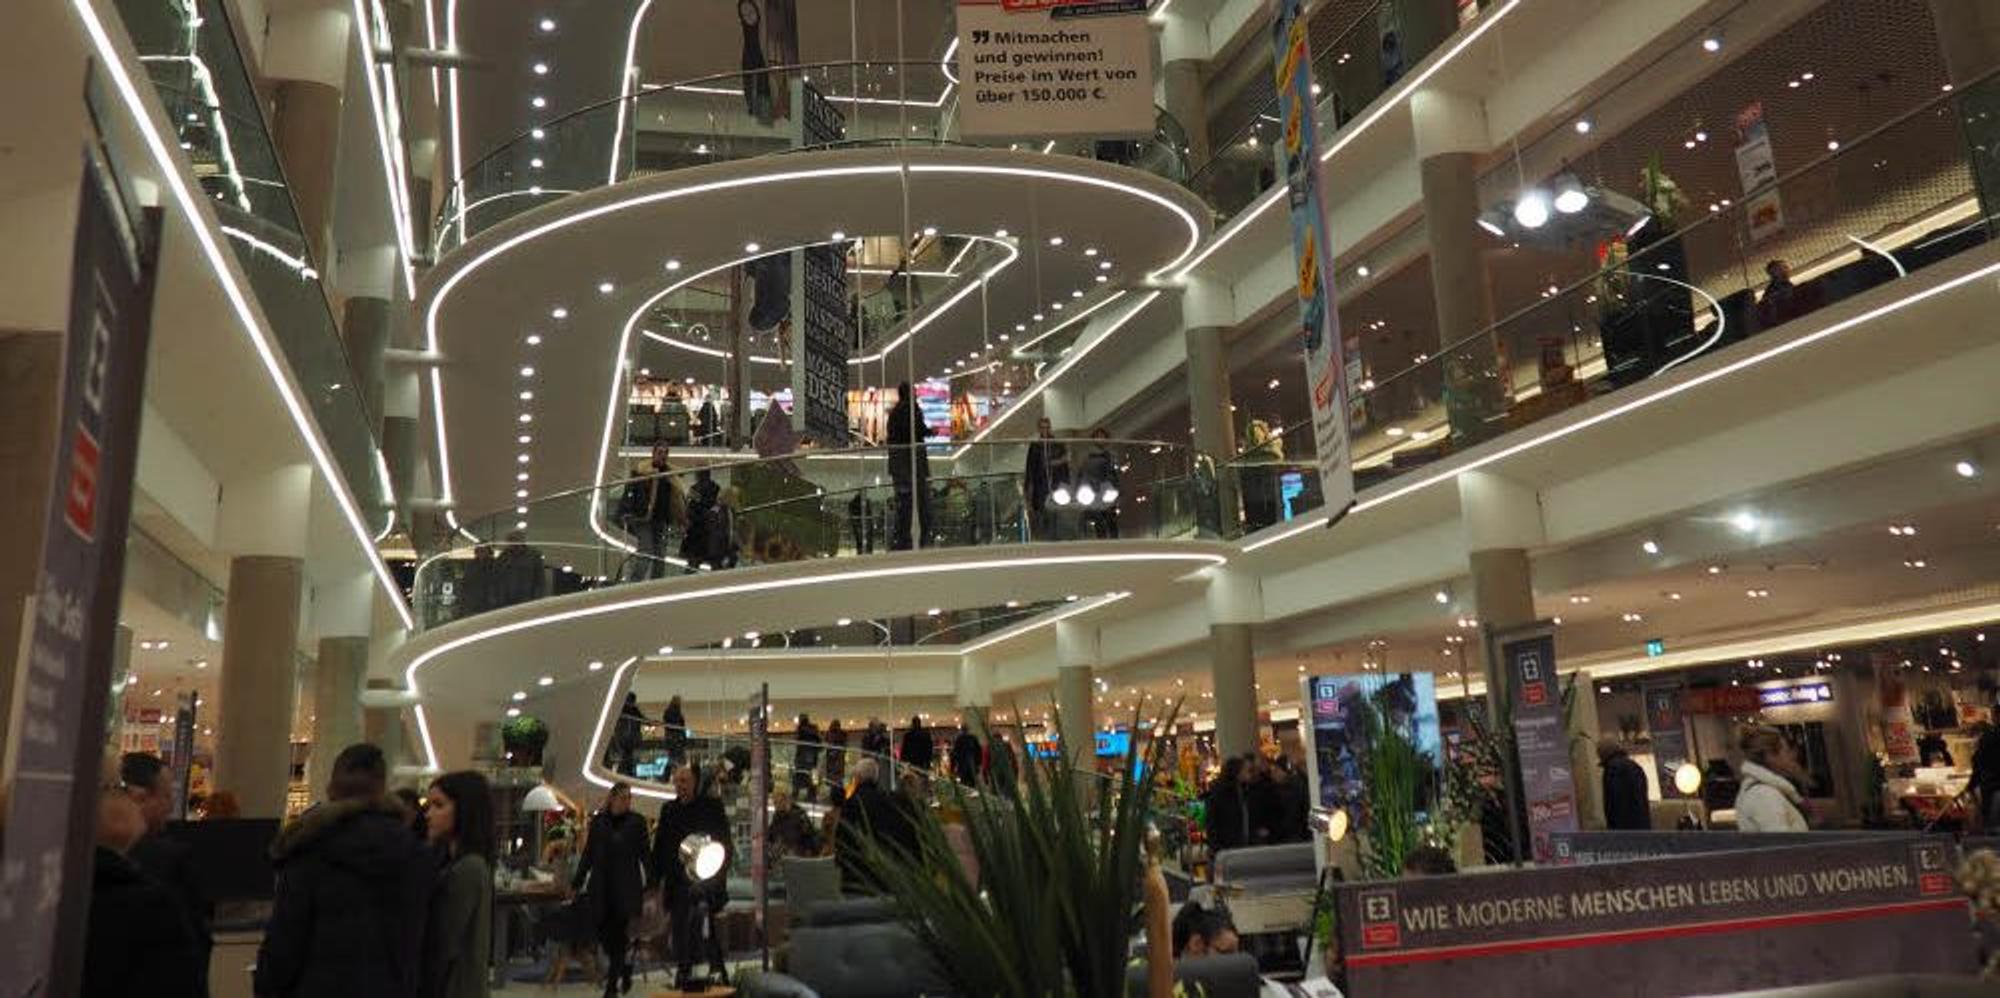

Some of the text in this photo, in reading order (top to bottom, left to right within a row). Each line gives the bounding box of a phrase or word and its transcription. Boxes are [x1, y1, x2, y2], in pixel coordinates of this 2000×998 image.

[995, 31, 1090, 44] Mitmachen
[975, 49, 1104, 67] und gewinnen!
[975, 69, 1137, 83] Preise im Wert von
[976, 90, 1016, 103] über
[1022, 88, 1087, 102] 150.000
[1402, 905, 1449, 932] WIE
[1457, 896, 1566, 928] MODERNE
[1571, 882, 1695, 917] MENSCHEN
[1700, 879, 1761, 905] LEBEN
[1764, 873, 1809, 899] UND
[1811, 865, 1914, 894] WOHNEN.
